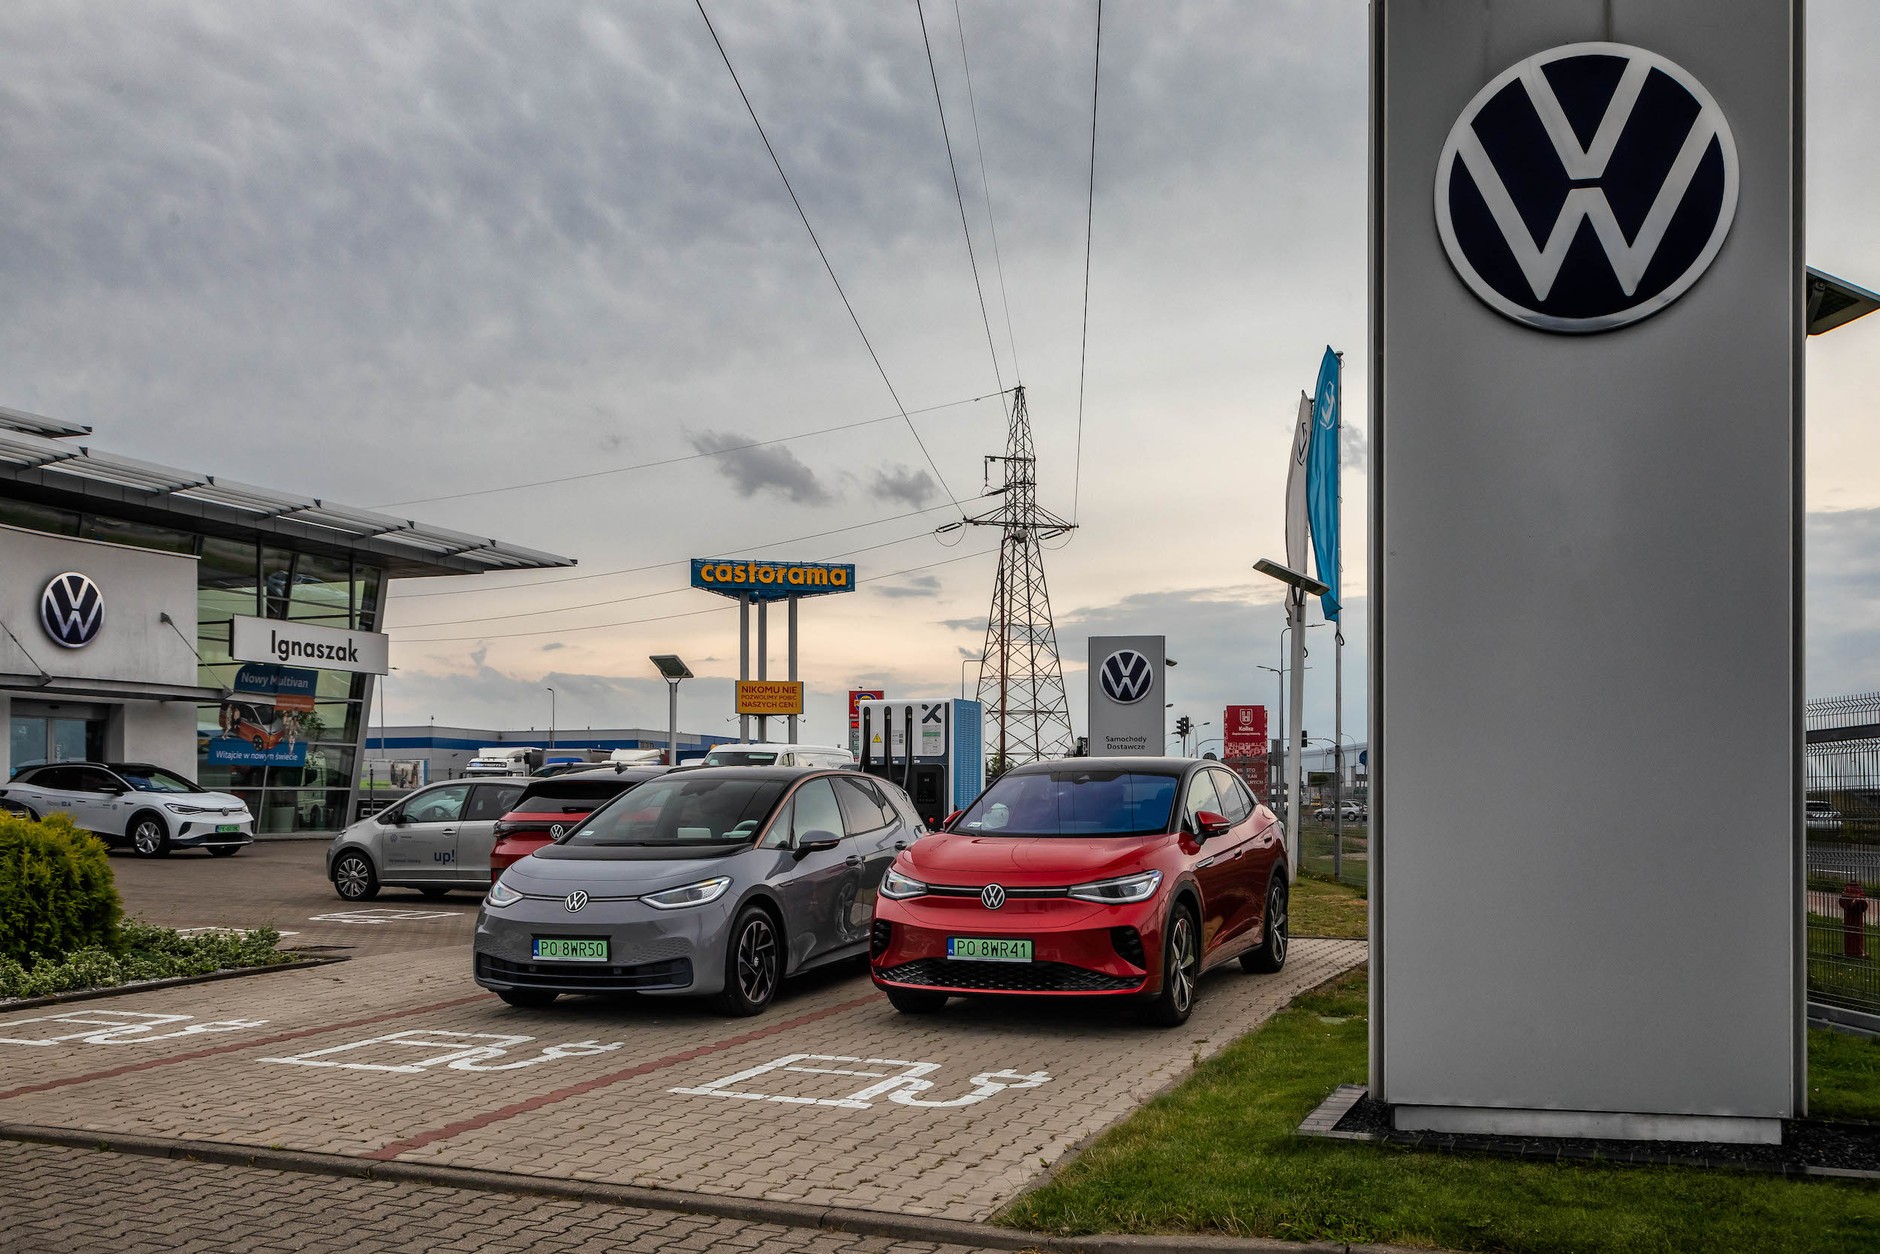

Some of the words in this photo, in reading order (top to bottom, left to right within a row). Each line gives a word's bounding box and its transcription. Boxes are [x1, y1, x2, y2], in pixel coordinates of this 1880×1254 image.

[701, 562, 846, 586] castorama
[271, 630, 358, 662] Ignaszak
[241, 672, 268, 687] Nowy
[270, 675, 308, 688] Multivan
[216, 751, 242, 760] Witajcie
[251, 753, 274, 761] nowym
[275, 752, 298, 760] świecie
[434, 849, 455, 865] up!
[541, 941, 558, 956] PO
[562, 942, 604, 957] 8WR50
[957, 940, 975, 956] PO
[981, 941, 1026, 957] 8WR41
